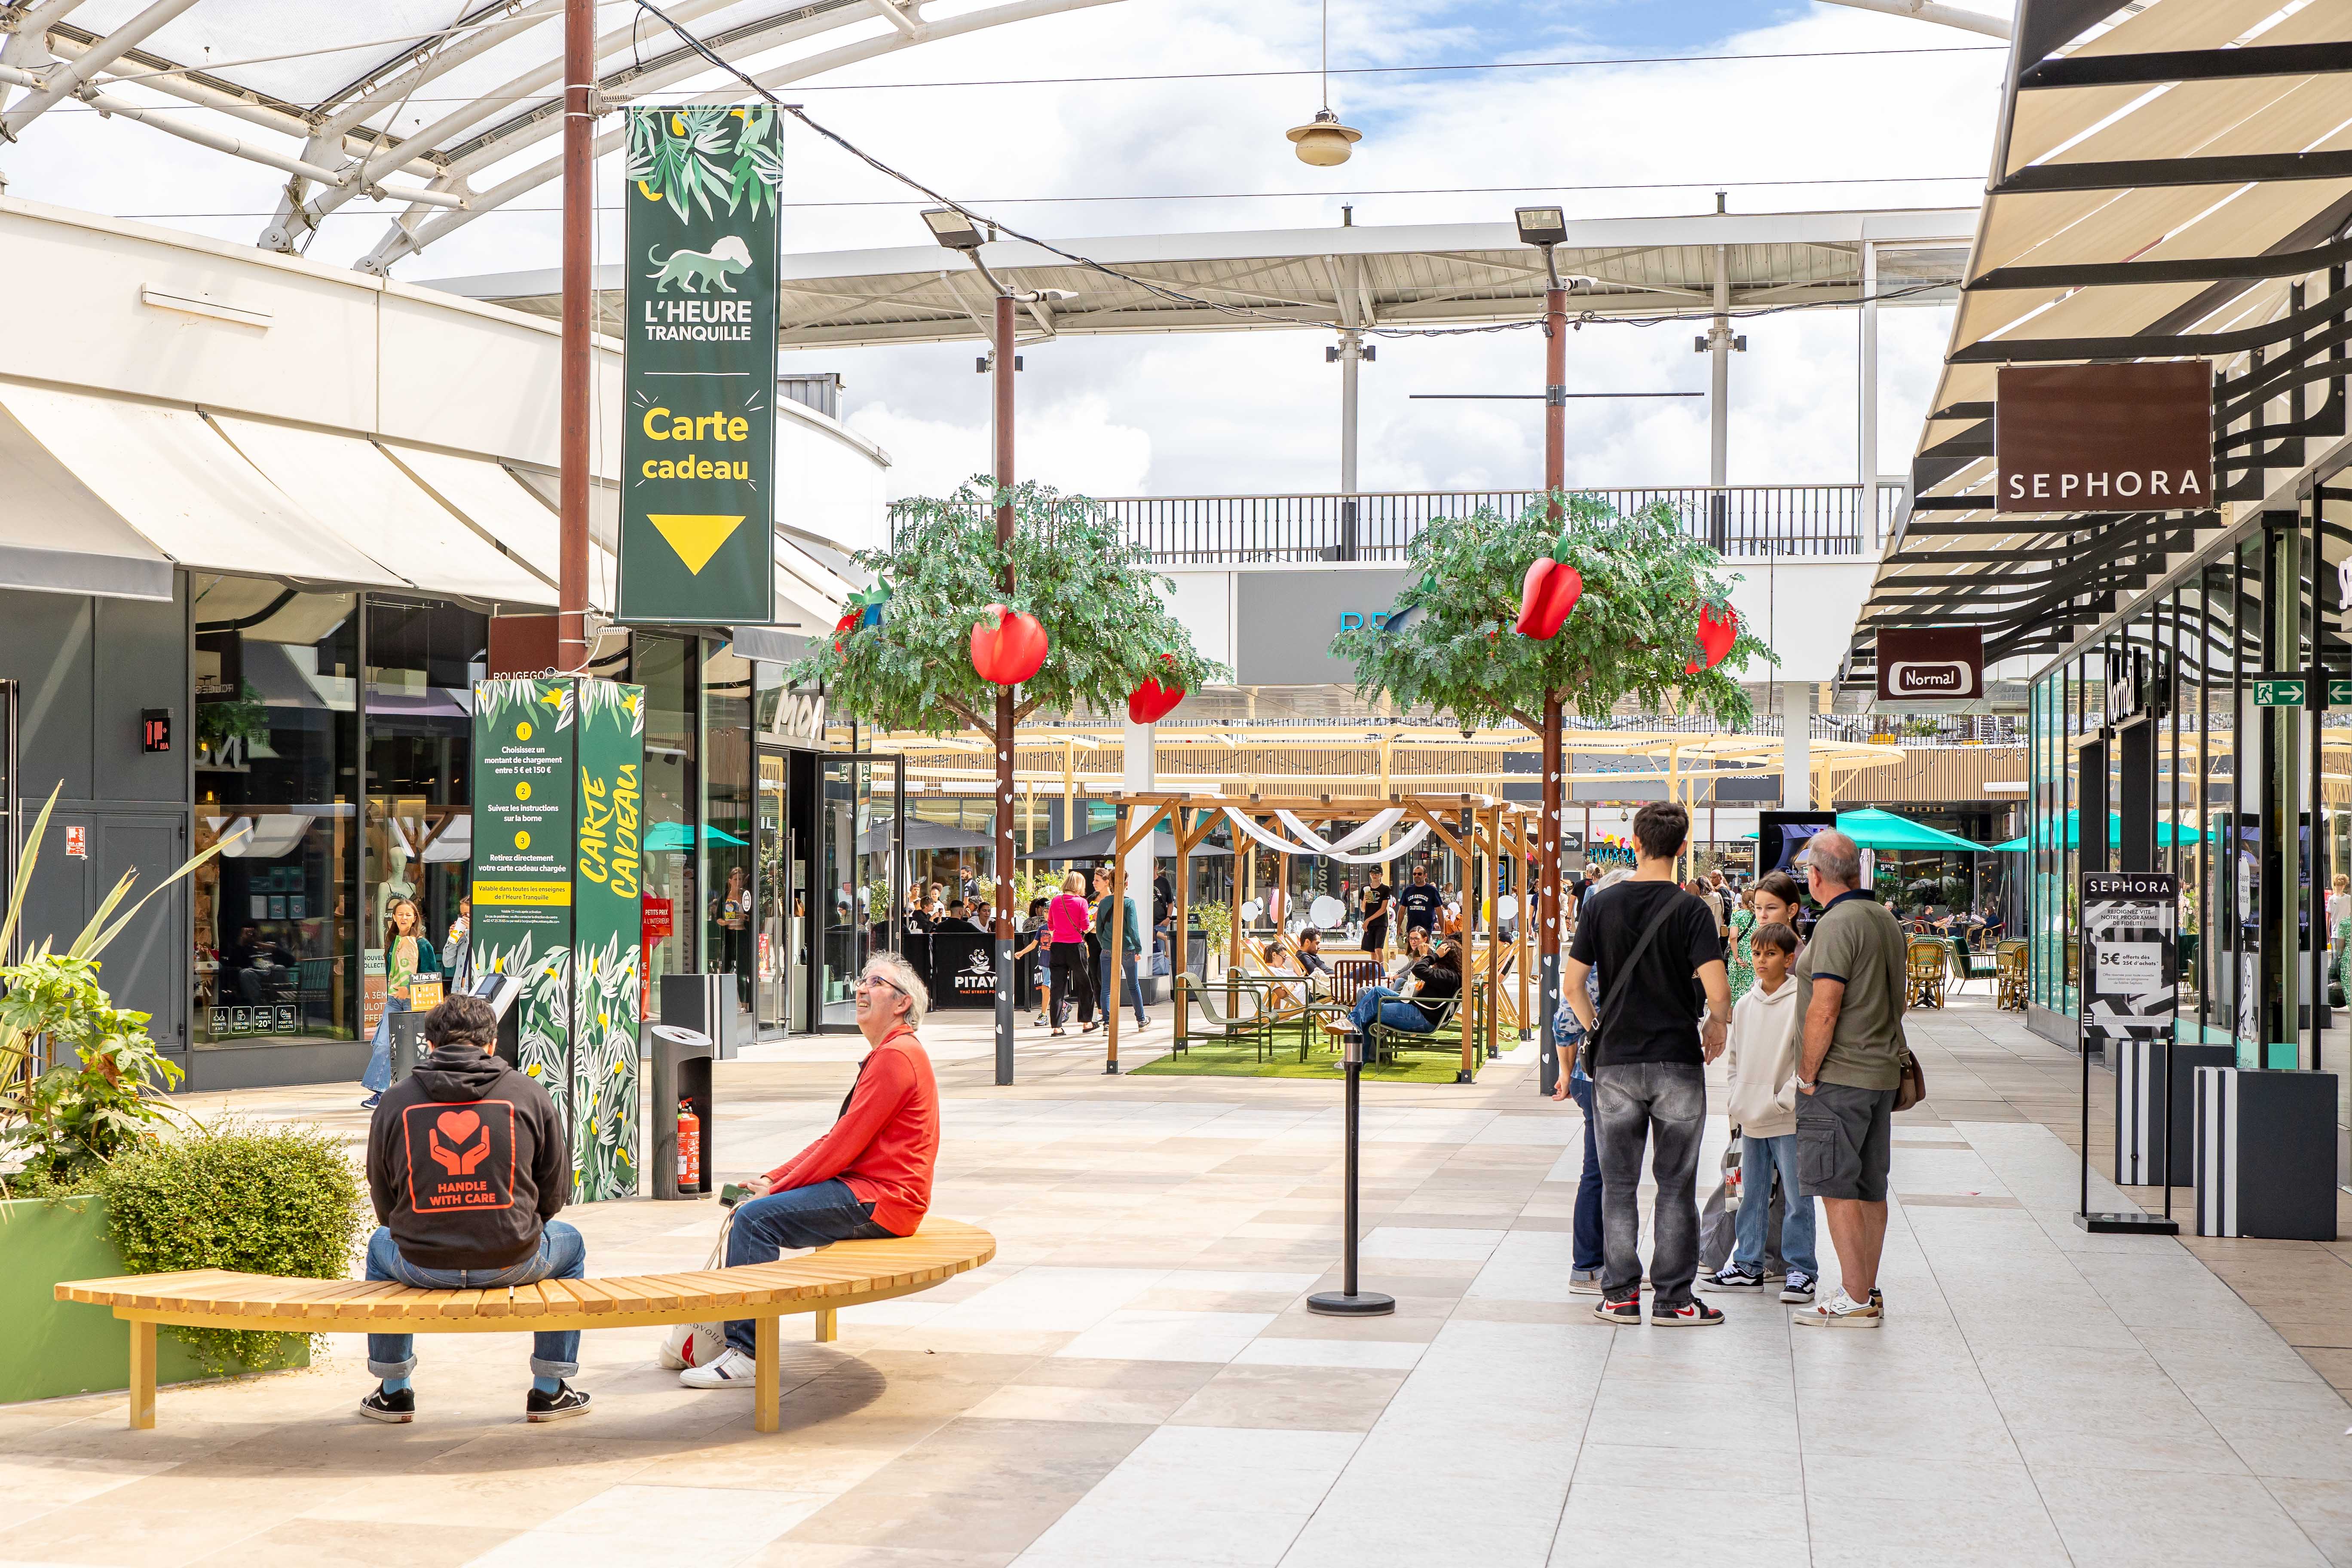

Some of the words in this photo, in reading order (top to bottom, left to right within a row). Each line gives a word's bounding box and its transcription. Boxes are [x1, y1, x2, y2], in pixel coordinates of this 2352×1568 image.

[646, 300, 752, 323] L'HEURE
[645, 325, 751, 342] TRANQUILLE
[643, 407, 749, 441] Carte
[642, 453, 749, 480] cadeau
[2010, 470, 2200, 499] SEPHORA
[493, 671, 545, 680] ROUGEGO
[1906, 670, 1954, 685] Normal
[773, 689, 824, 742] MOA
[580, 766, 615, 883] CARTE
[611, 764, 640, 898] CADEAU
[539, 865, 566, 873] chargée
[2091, 881, 2169, 892] SEPHORA
[2101, 953, 2120, 965] 5€
[955, 977, 995, 987] PITAY
[1034, 972, 1043, 984] PITA
[372, 990, 387, 999] 3ÈM
[438, 1181, 487, 1193] HANDLE
[430, 1194, 461, 1205] WITH
[466, 1193, 495, 1204] CARE
